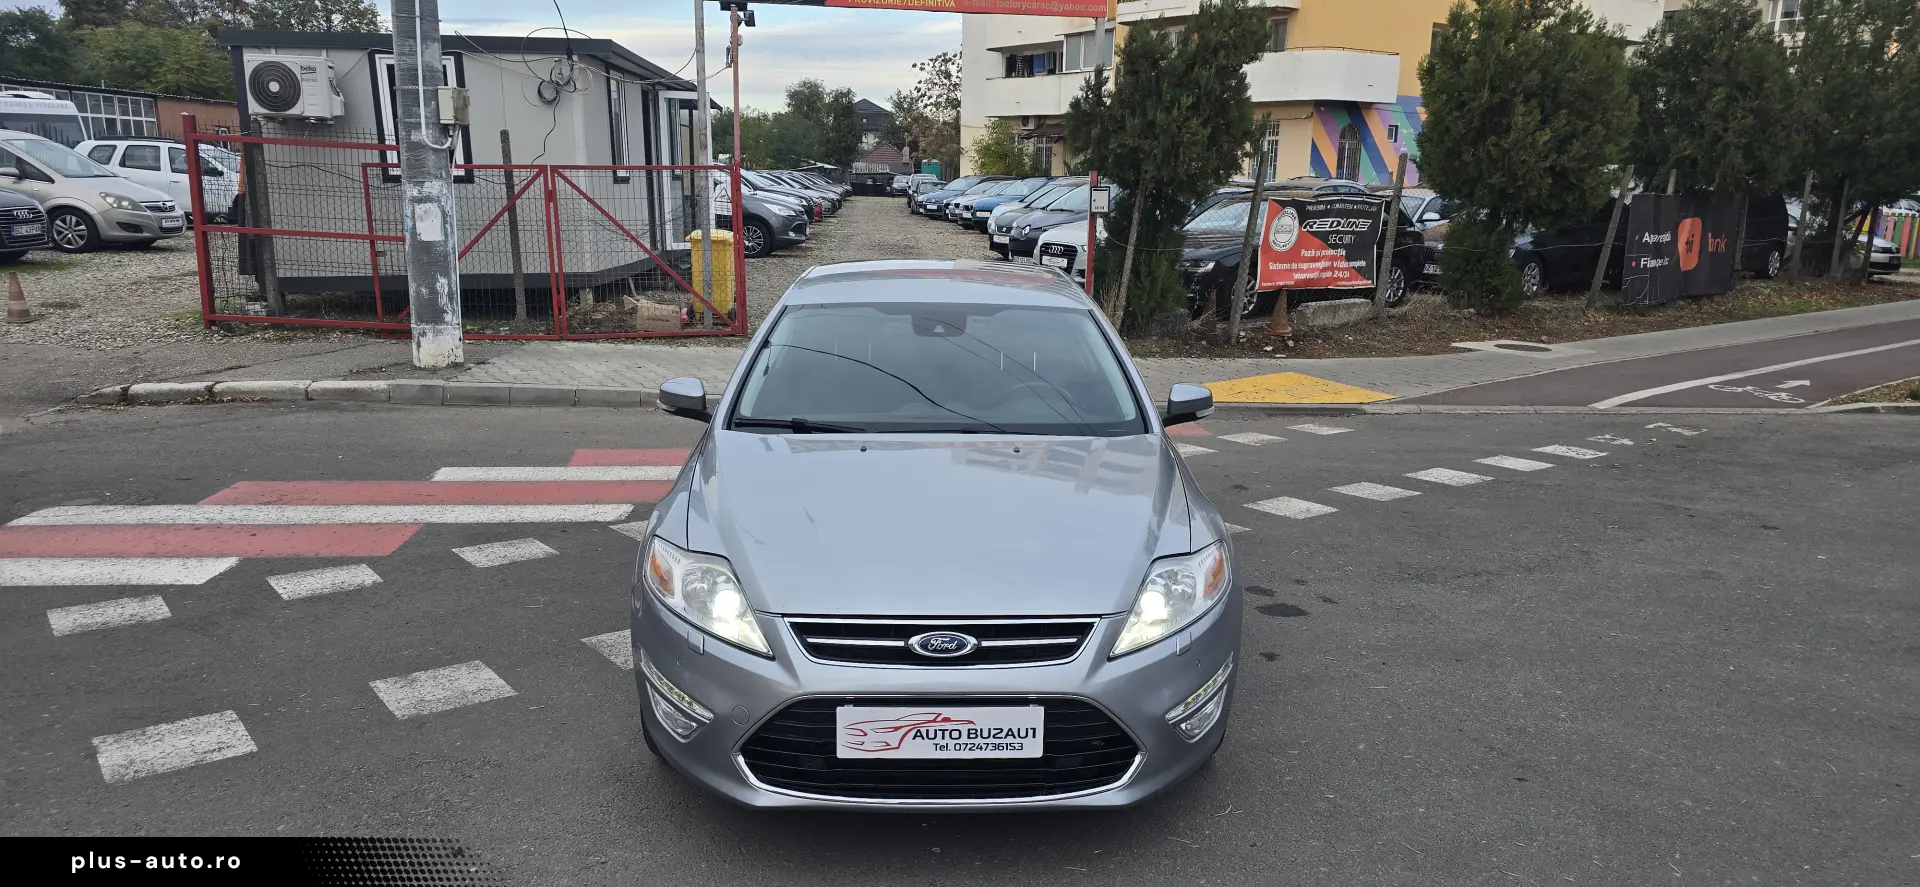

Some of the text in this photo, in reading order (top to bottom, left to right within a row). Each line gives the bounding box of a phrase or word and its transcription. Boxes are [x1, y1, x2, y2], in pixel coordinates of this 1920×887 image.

[1302, 218, 1373, 231] REDLINE
[1291, 261, 1298, 269] de
[928, 637, 958, 651] Ford
[912, 728, 962, 741] AUTO
[933, 742, 1024, 752] Tel. 0724736153
